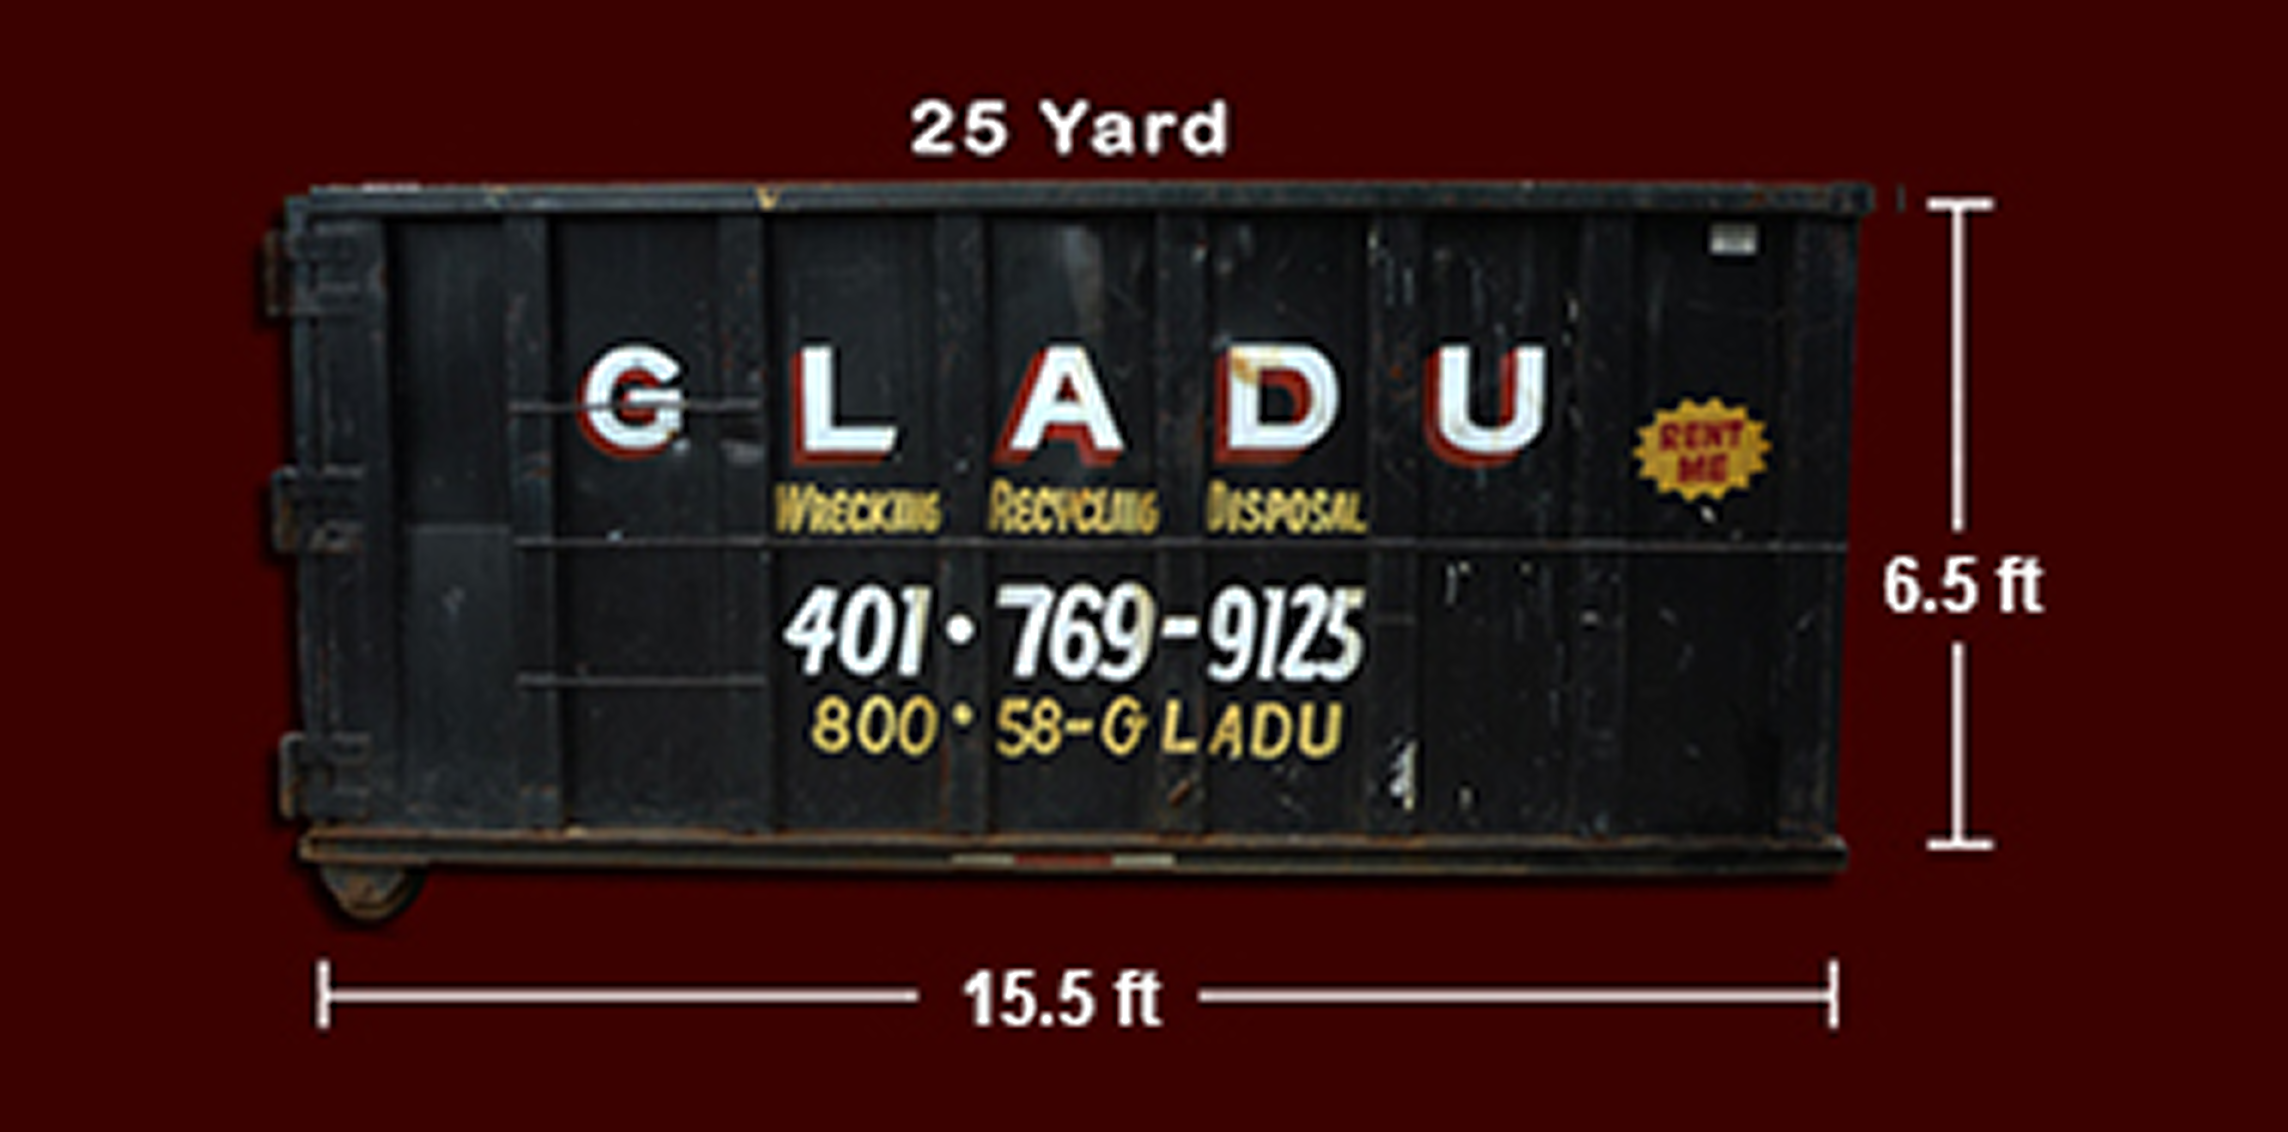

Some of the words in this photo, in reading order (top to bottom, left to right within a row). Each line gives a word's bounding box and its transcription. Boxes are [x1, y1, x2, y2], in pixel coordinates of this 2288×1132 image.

[576, 346, 1544, 467] GLADU
[1659, 420, 1743, 450] RENT
[1677, 453, 1727, 483] ME
